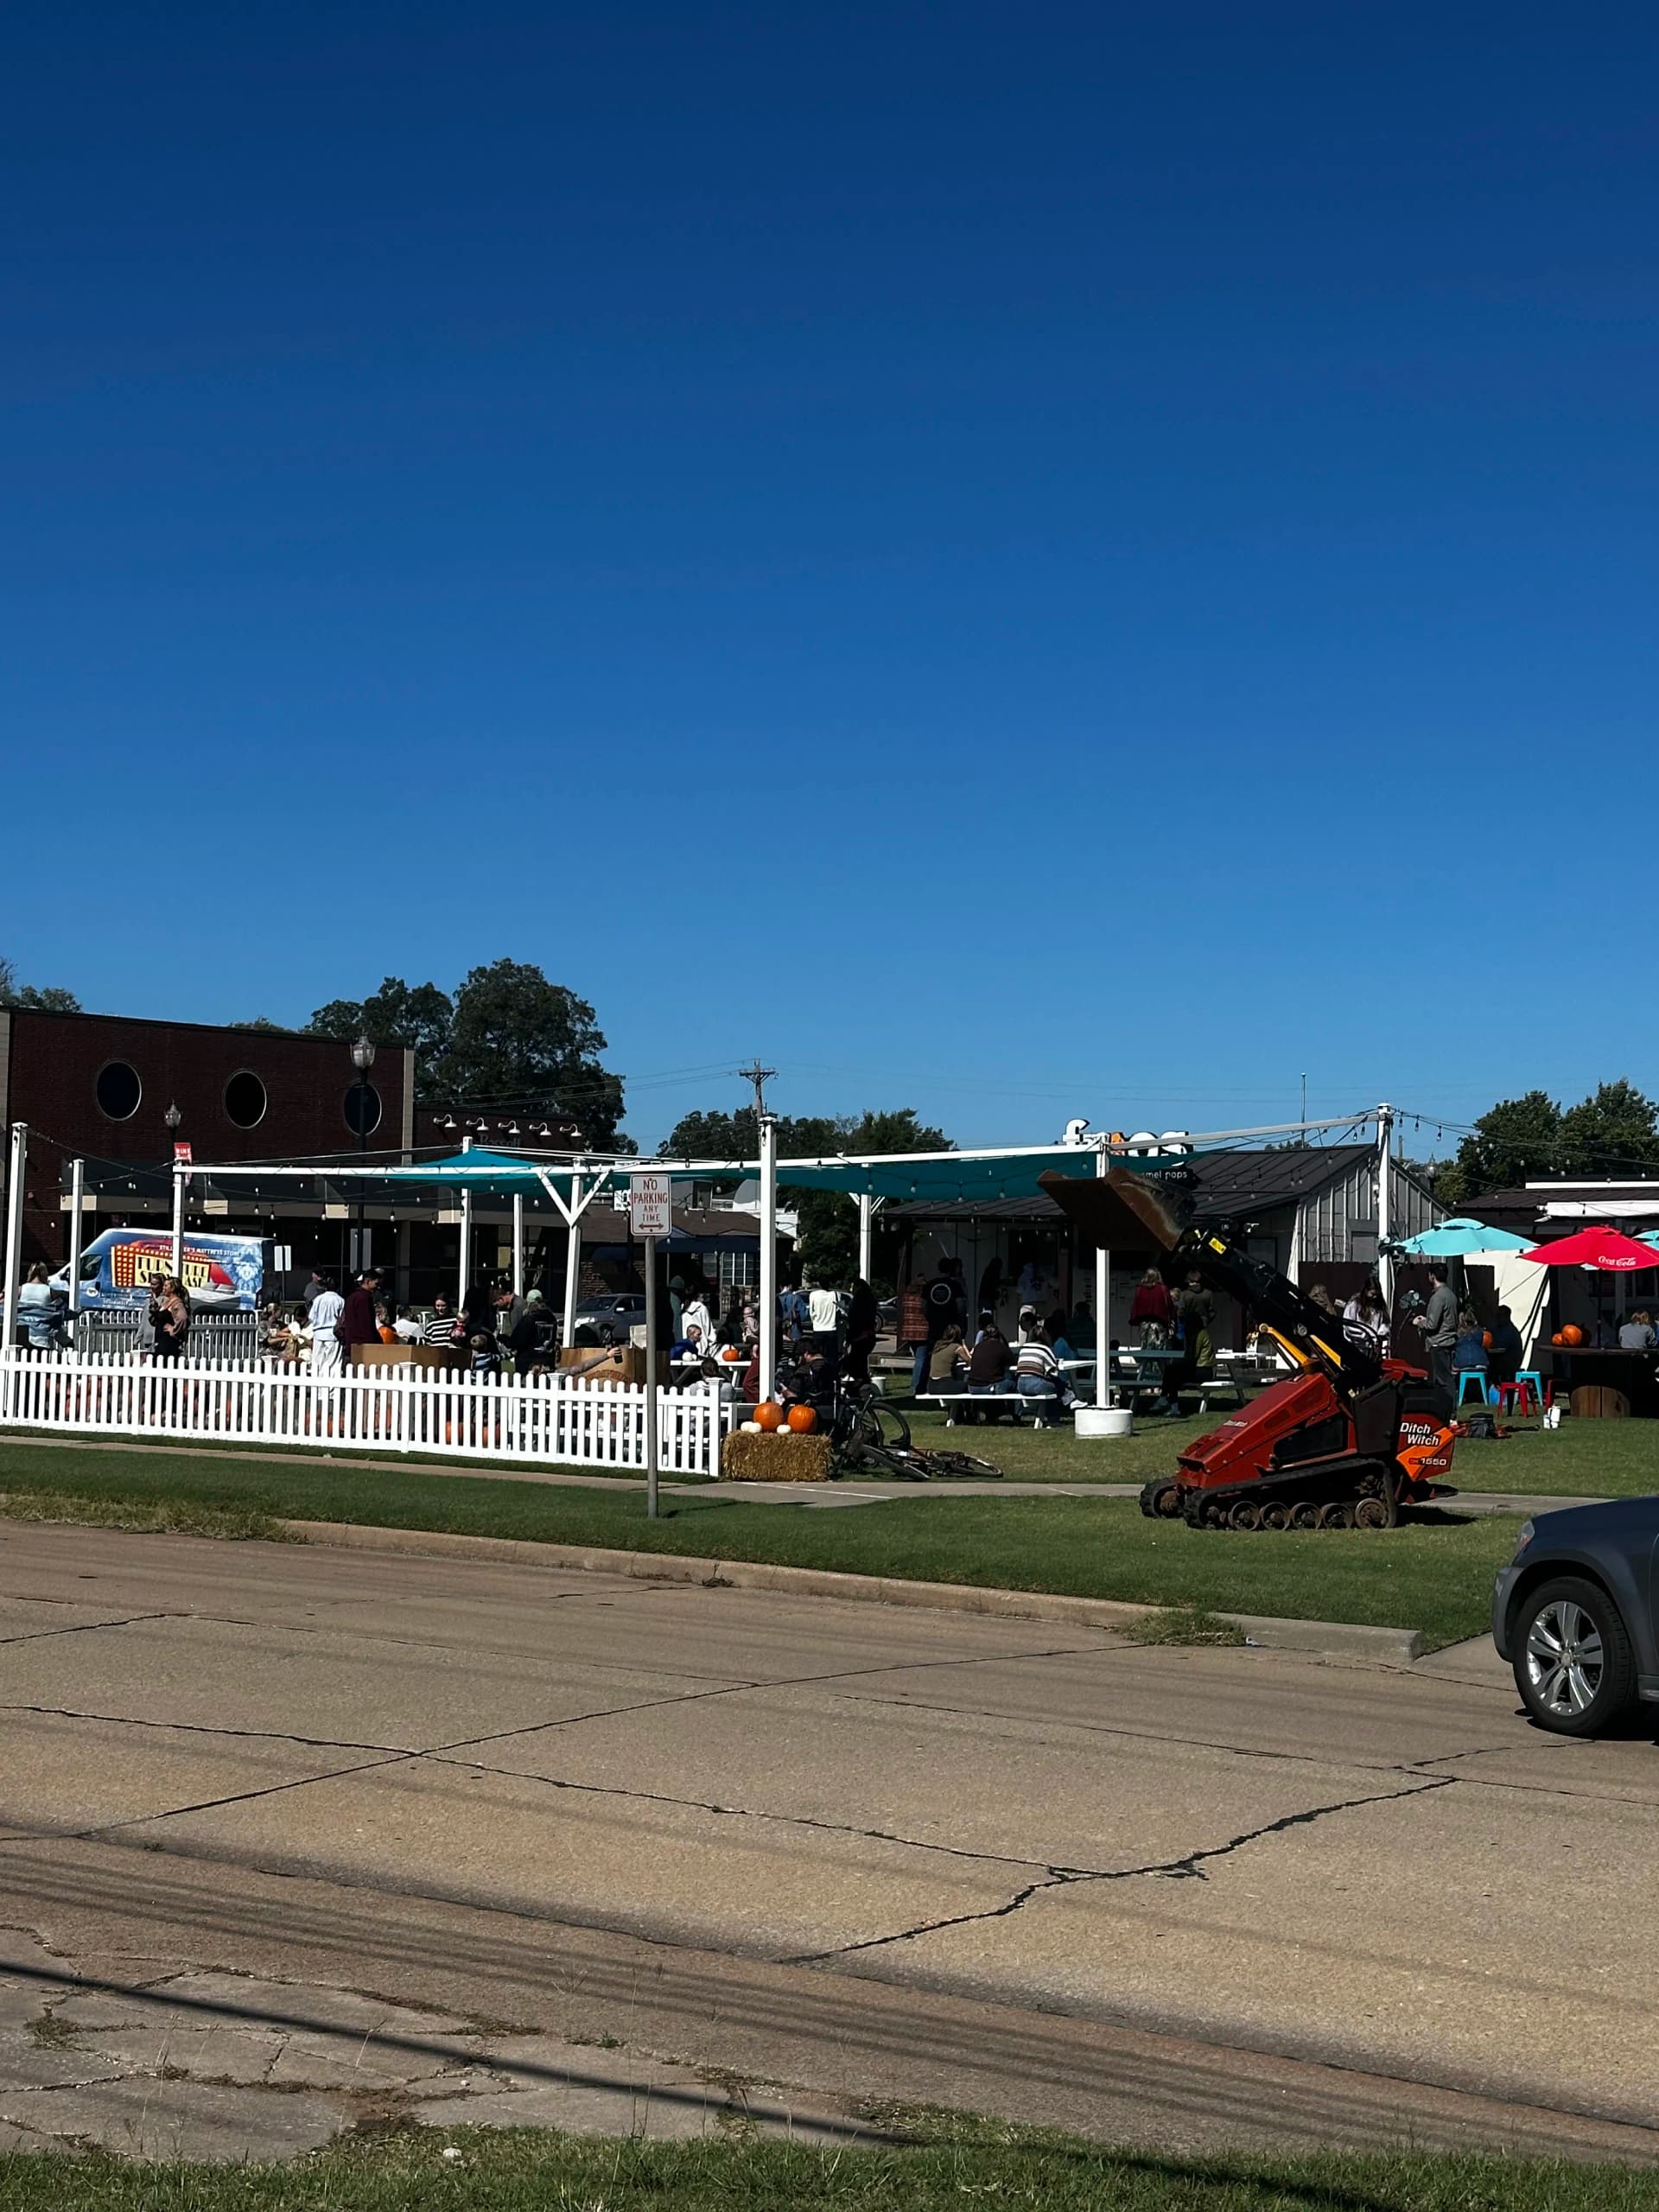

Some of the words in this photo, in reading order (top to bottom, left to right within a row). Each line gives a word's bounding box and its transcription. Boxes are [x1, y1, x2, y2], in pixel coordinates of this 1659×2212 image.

[643, 1179, 658, 1191] NO
[633, 1192, 668, 1204] PARKING
[643, 1205, 658, 1213] ANY
[1399, 1422, 1431, 1434] Ditch
[1408, 1434, 1440, 1446] Witch
